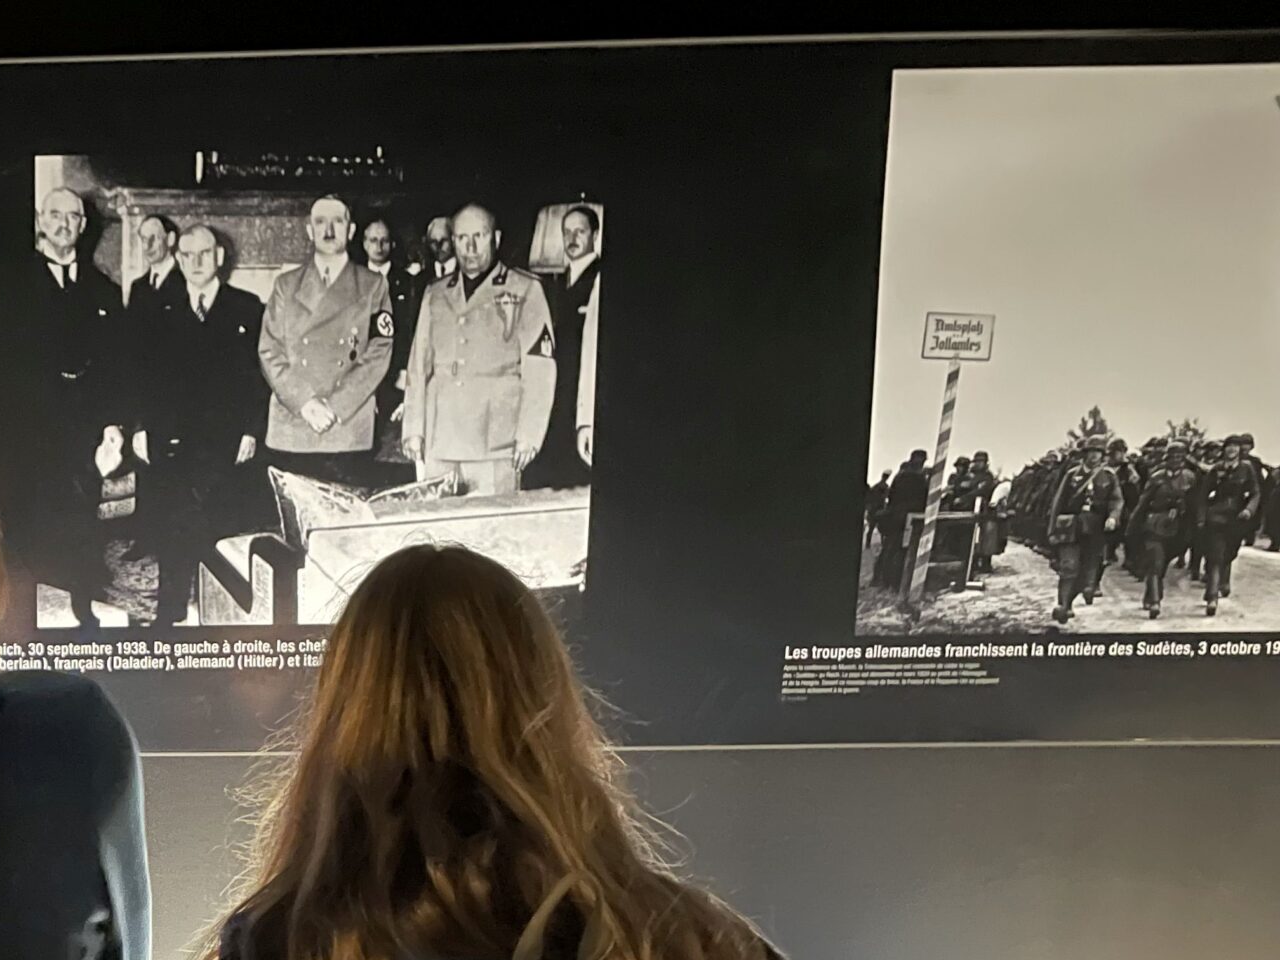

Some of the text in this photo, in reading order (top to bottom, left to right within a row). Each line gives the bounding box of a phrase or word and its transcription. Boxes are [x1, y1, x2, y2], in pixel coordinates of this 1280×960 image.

[28, 642, 44, 657] 30
[47, 641, 114, 660] septembre
[116, 640, 151, 656] 1938.
[154, 640, 171, 654] De
[174, 639, 220, 657] gauche
[222, 639, 231, 653] à
[234, 639, 273, 655] droite,
[277, 638, 295, 653] les
[298, 638, 327, 653] chef
[784, 640, 1280, 662] Les troupes allemandes franchissent la frontière des Sudètes, 3 octobre 19
[54, 656, 104, 673] français
[106, 654, 175, 671] (Daladier),
[177, 653, 235, 669] allemand
[238, 653, 284, 670] (Hitler)
[287, 653, 300, 668] et
